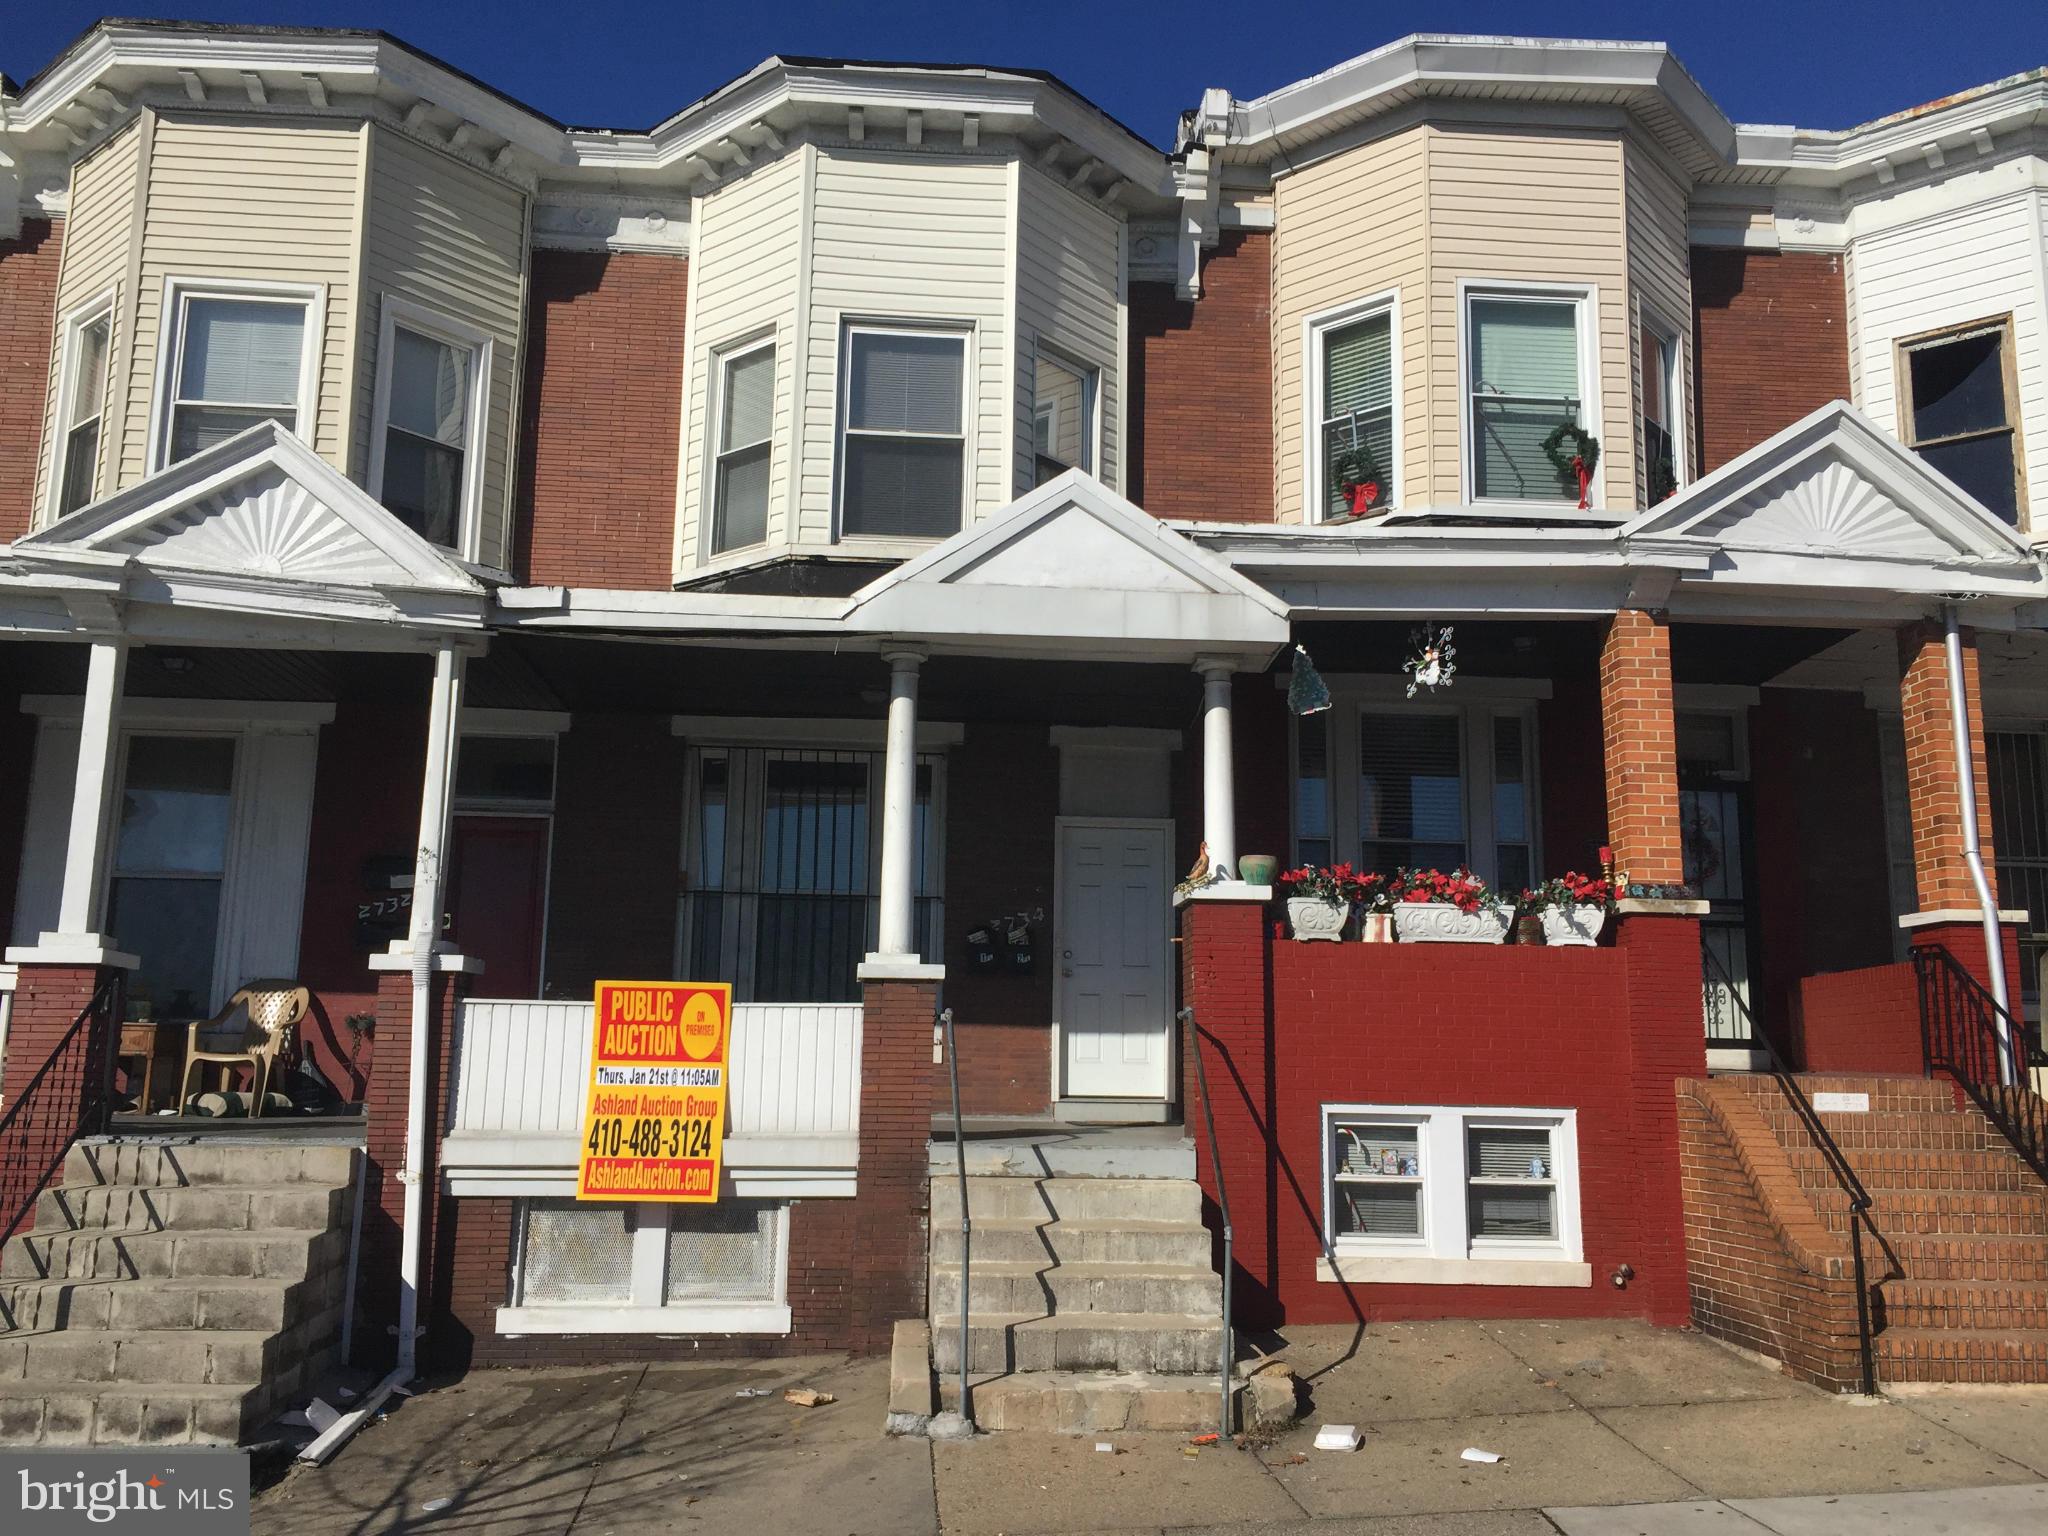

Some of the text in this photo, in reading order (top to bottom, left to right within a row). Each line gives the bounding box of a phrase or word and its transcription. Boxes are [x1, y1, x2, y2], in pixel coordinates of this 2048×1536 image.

[358, 894, 412, 919] 2732
[611, 990, 674, 1022] PUBLIC
[696, 1010, 706, 1023] ON
[603, 1024, 678, 1056] AUCTION
[685, 1024, 716, 1037] PREMISES
[629, 1068, 646, 1085] Jan
[649, 1068, 670, 1085] 21st
[671, 1070, 679, 1087] @
[681, 1069, 719, 1086] 11:05AM
[593, 1094, 718, 1120] Ashland Auction Group
[588, 1118, 712, 1158] 410-488-3124
[587, 1160, 711, 1191] AshlandAuction.com
